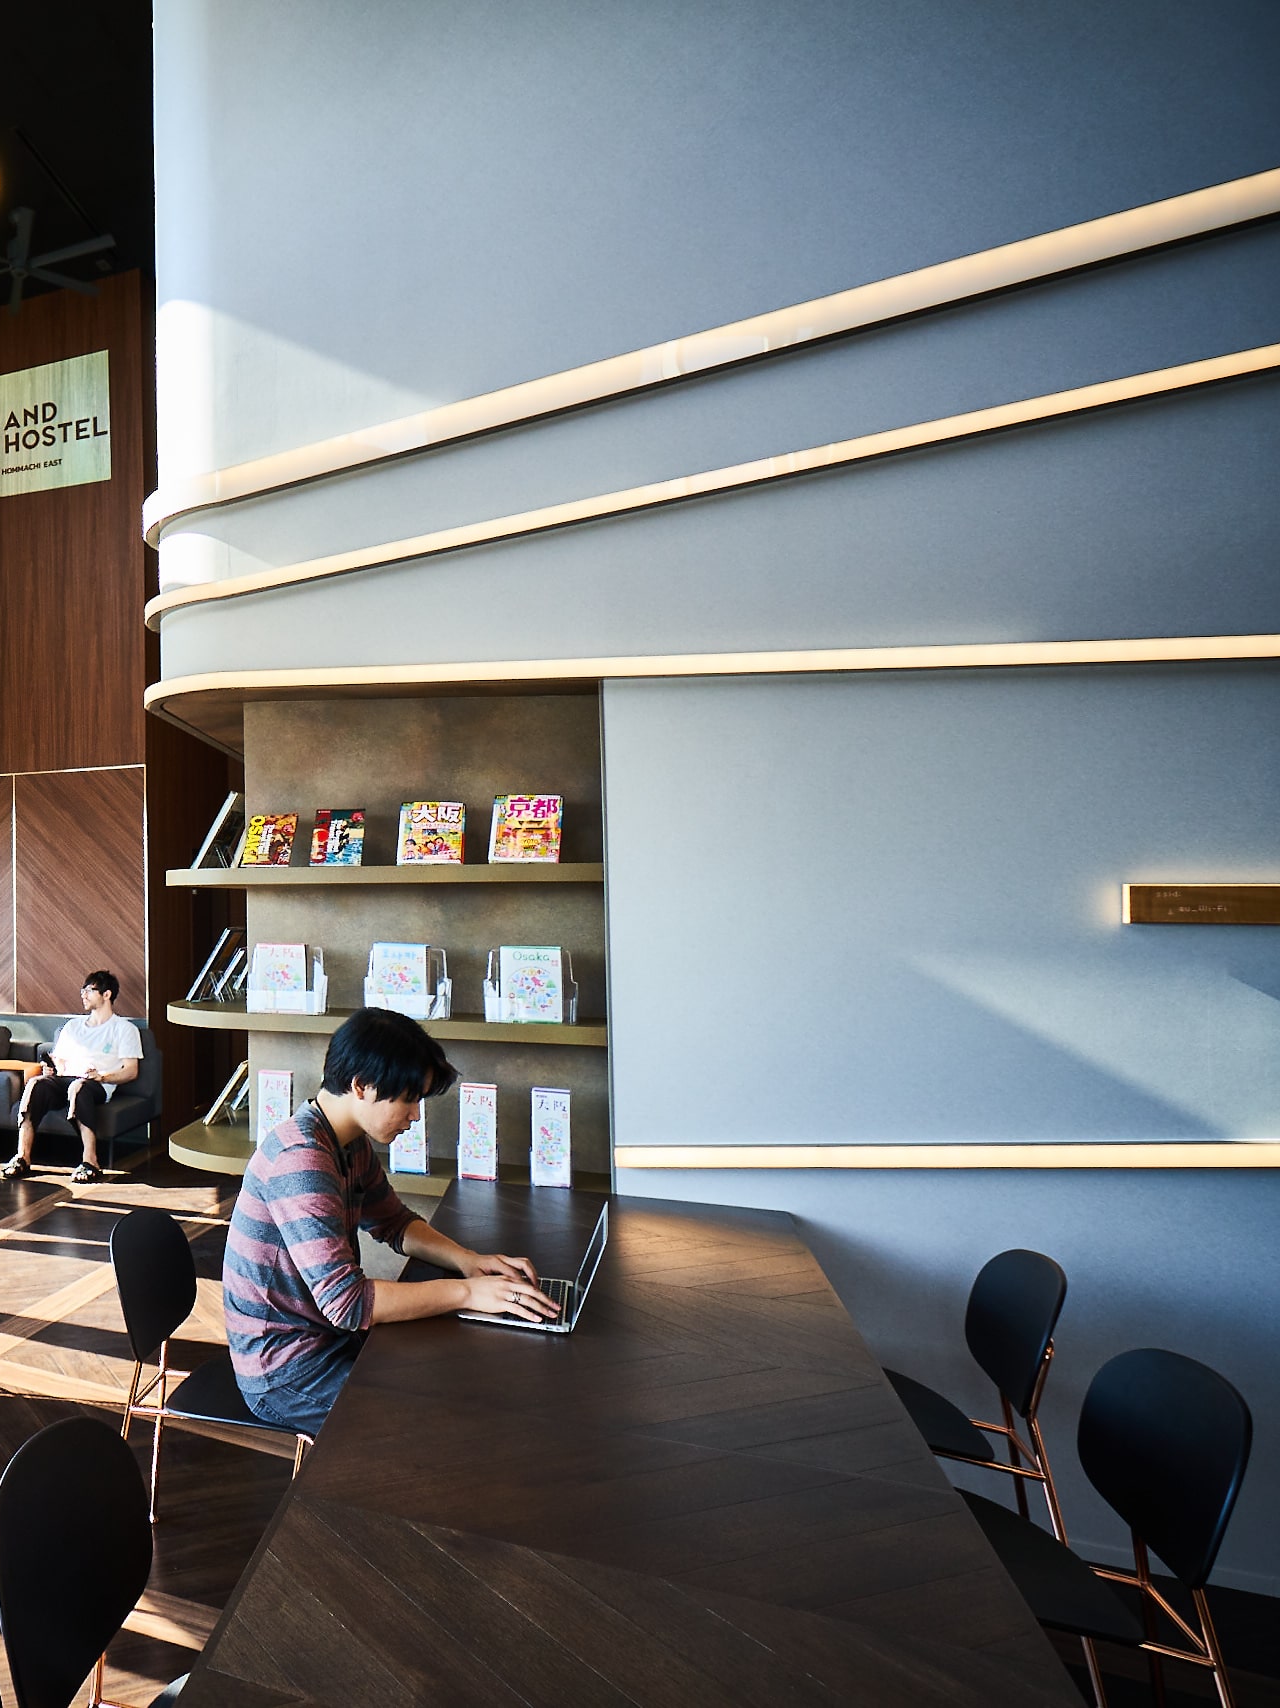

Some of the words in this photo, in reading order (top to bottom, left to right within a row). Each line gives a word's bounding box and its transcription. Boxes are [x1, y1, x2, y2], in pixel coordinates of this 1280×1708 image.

[4, 402, 57, 431] AND
[4, 416, 108, 454] HOSTEL
[1, 463, 41, 476] HOMMACHI
[43, 458, 63, 469] EAST
[412, 804, 462, 823] 大阪
[506, 797, 559, 818] 京都
[242, 814, 266, 864] OSAKA
[512, 950, 550, 961] Osaka
